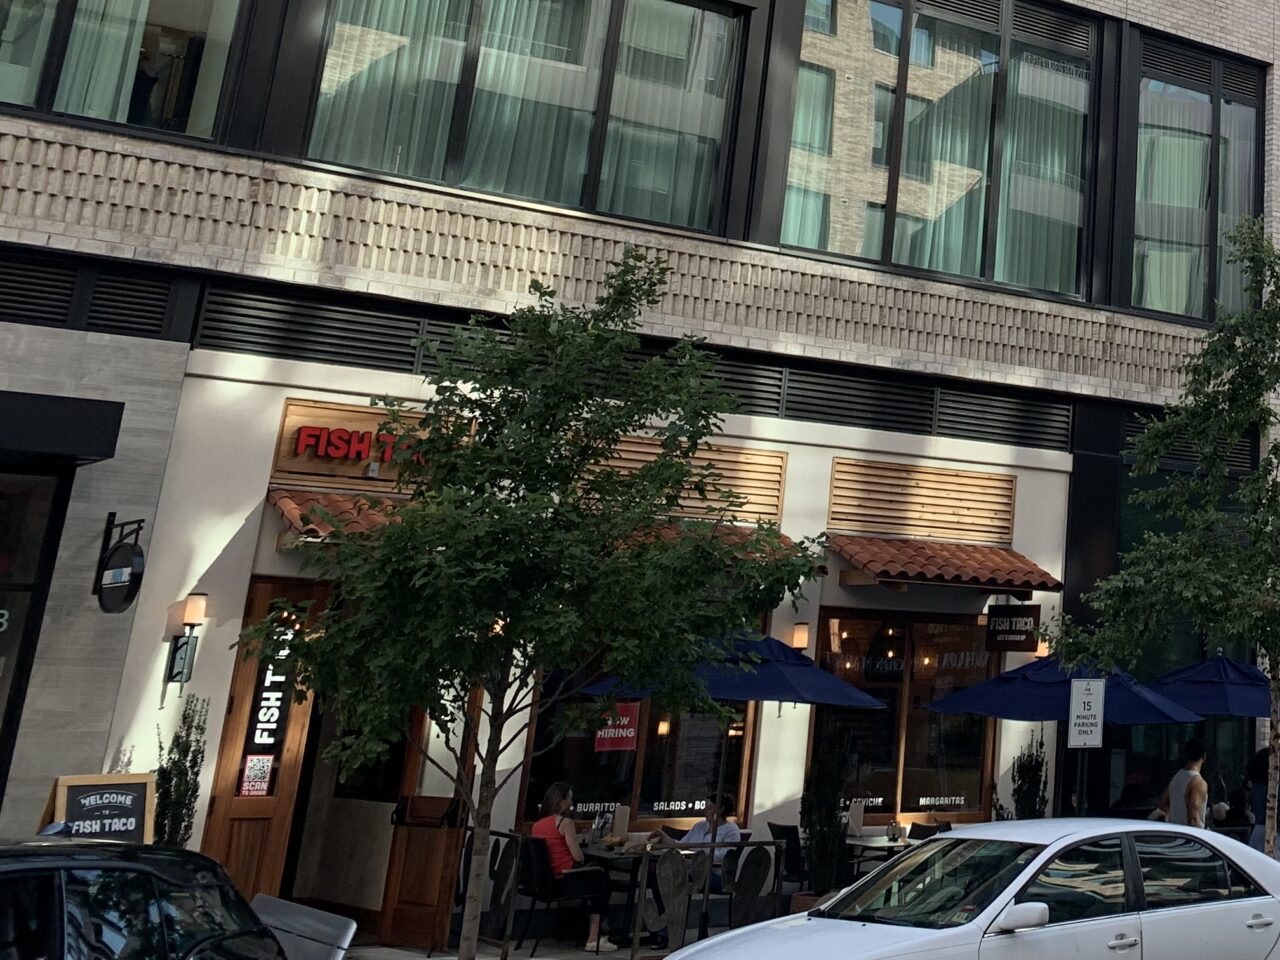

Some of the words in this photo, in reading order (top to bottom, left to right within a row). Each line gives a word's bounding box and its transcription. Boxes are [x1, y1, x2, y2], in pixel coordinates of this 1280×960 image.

[296, 425, 373, 462] FISH
[990, 617, 1010, 630] FISH
[1011, 617, 1034, 631] TACO
[1082, 701, 1092, 711] 15
[254, 691, 283, 745] FISH
[597, 728, 635, 738] HIRING
[242, 781, 268, 791] SCAN
[80, 793, 134, 807] WELCOME
[653, 801, 687, 811] SALADS
[919, 796, 965, 806] MARGARITAS
[71, 819, 101, 834] FISH
[103, 817, 136, 832] TACO
